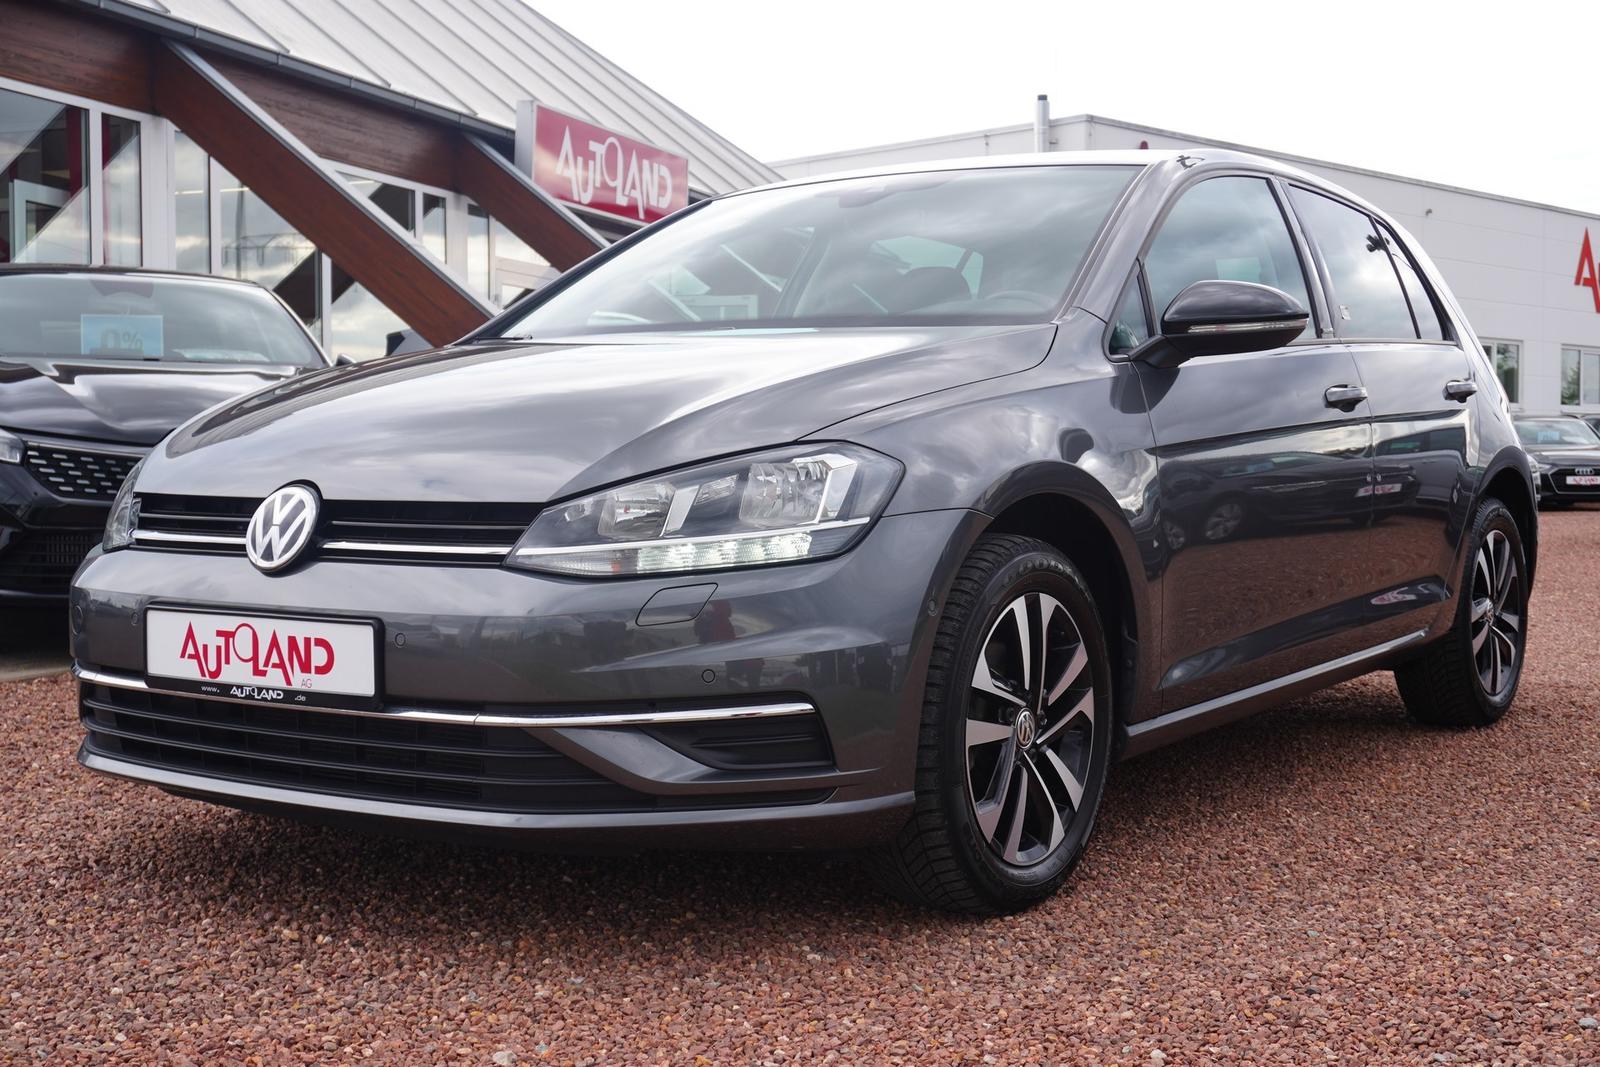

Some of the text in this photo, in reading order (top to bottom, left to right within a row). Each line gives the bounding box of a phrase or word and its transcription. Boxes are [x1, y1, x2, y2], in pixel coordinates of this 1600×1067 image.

[555, 124, 673, 220] AUTOLAND
[179, 621, 335, 687] AUTOLAND
[230, 686, 284, 700] AUTOLAND
[300, 678, 313, 689] AG
